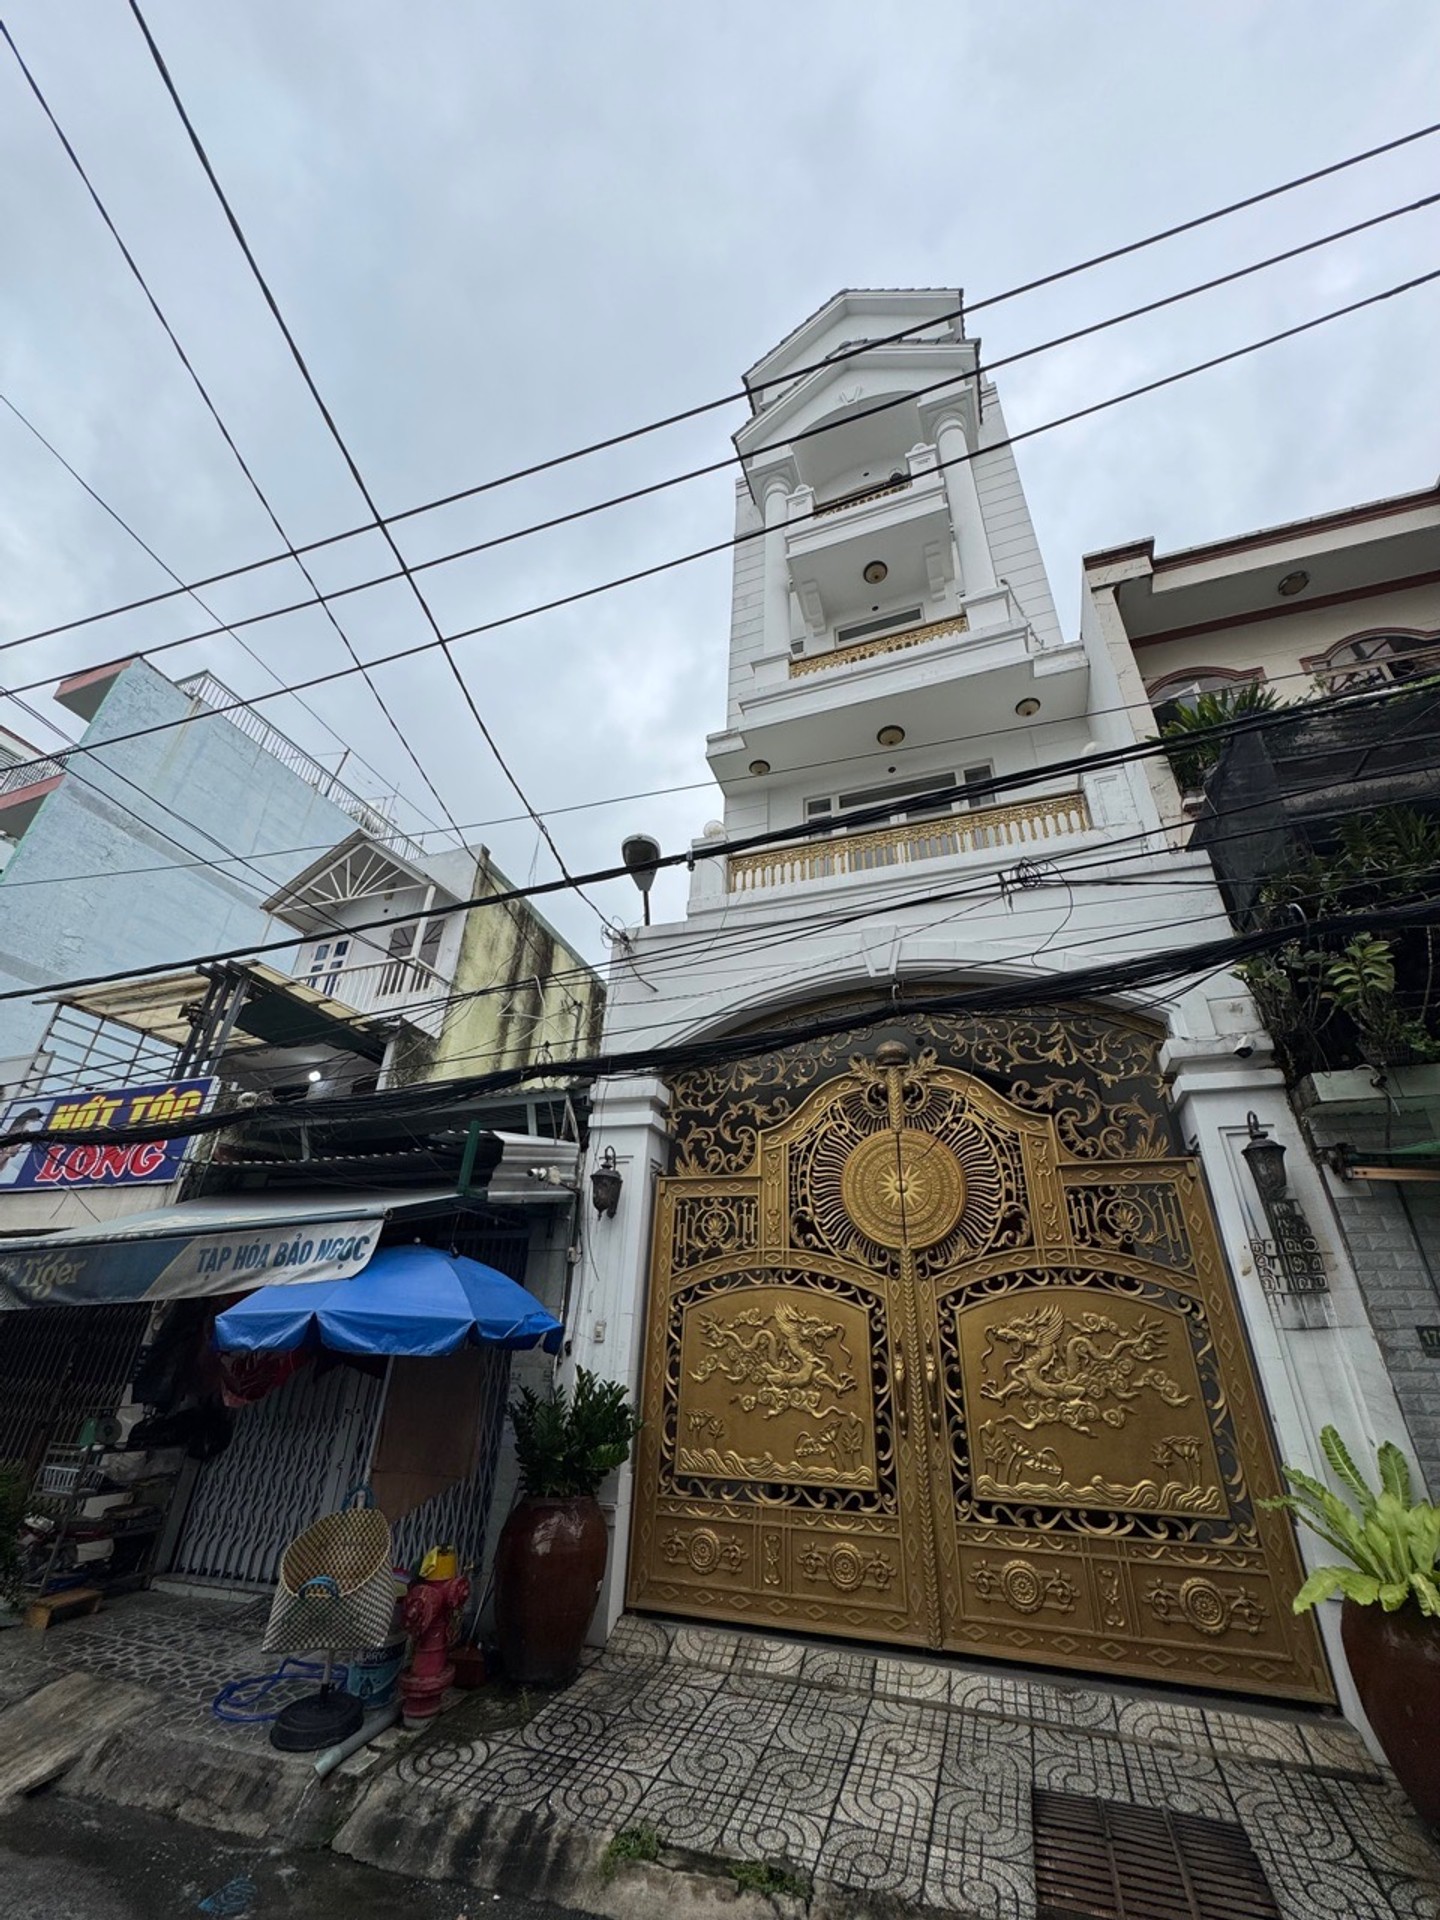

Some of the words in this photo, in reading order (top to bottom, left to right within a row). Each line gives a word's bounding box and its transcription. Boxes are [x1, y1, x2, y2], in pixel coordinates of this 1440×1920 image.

[129, 1087, 202, 1124] TÓC
[35, 1140, 168, 1182] LONG
[18, 1252, 88, 1300] Tiger
[197, 1247, 232, 1281] TẠP
[232, 1238, 272, 1271] HÓA
[273, 1233, 314, 1268] BẢO
[314, 1235, 370, 1270] NGỌC
[1422, 1330, 1440, 1346] 17
